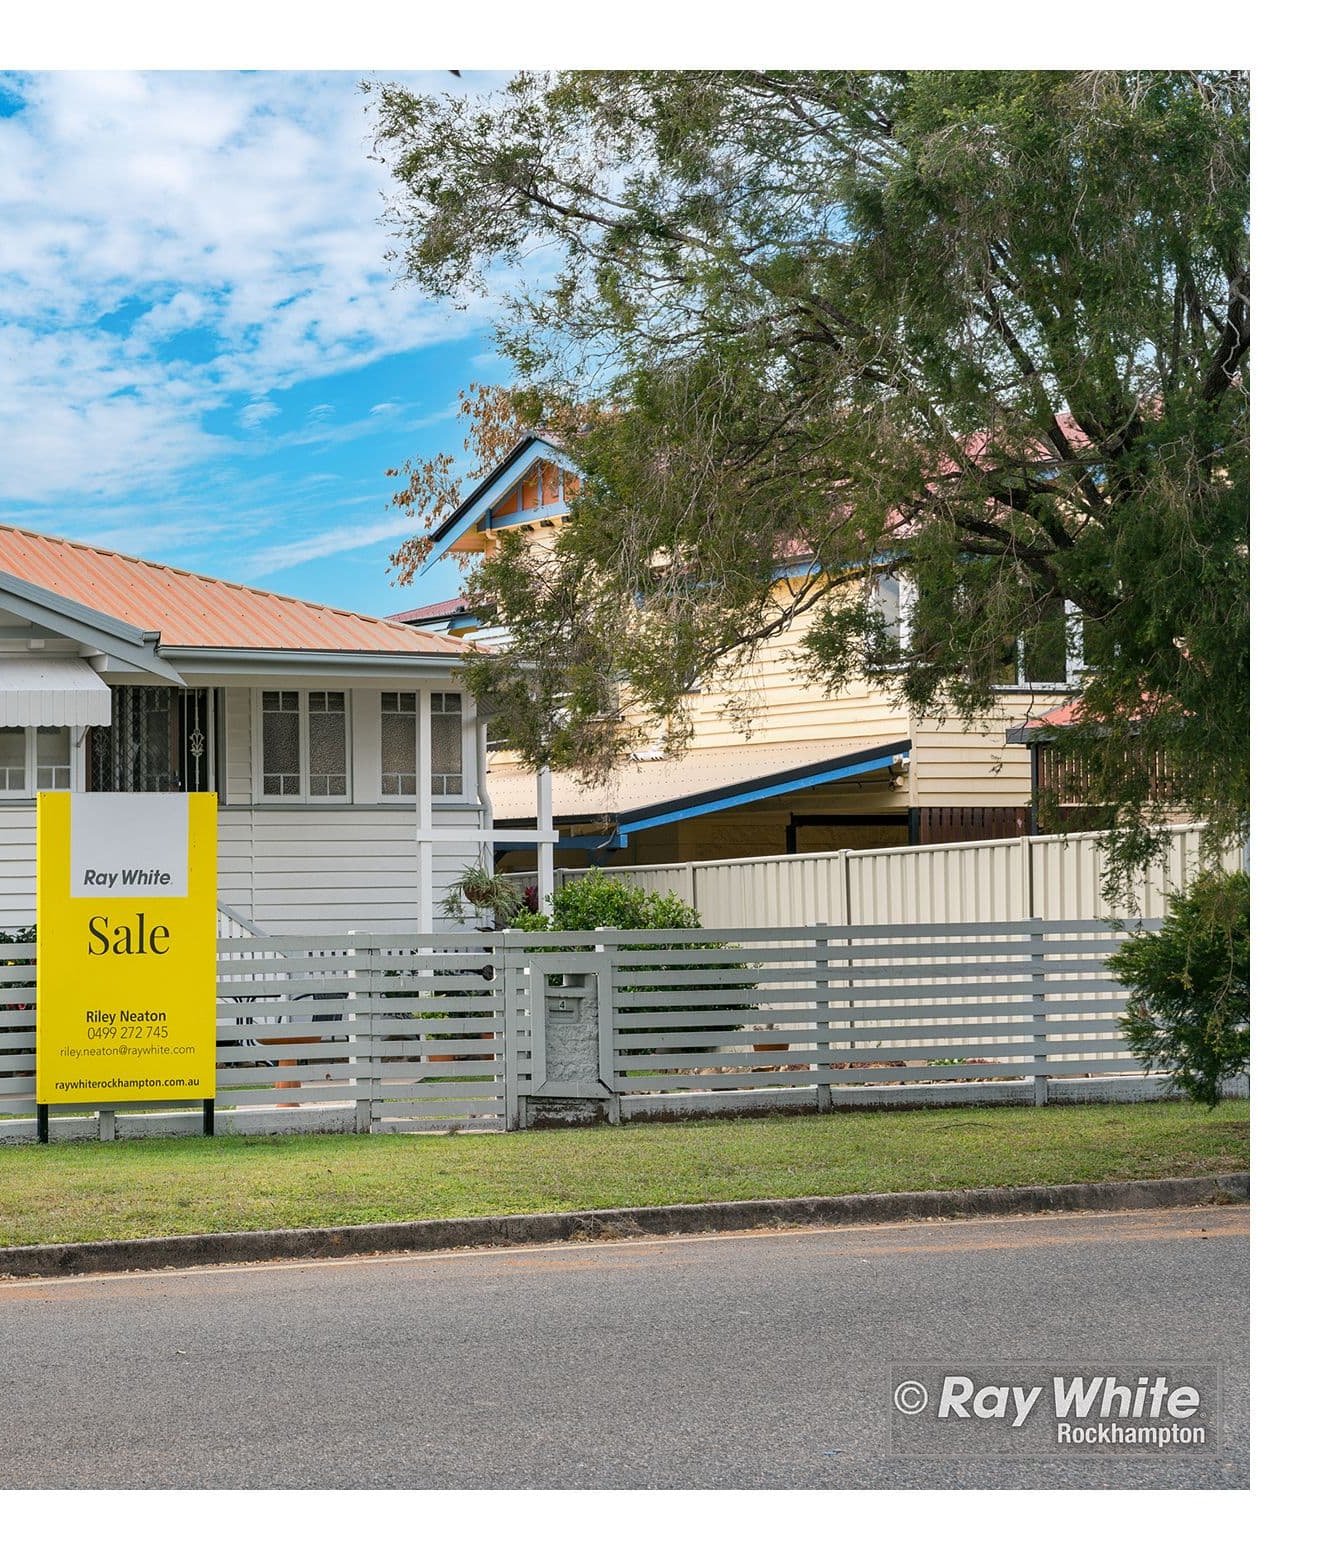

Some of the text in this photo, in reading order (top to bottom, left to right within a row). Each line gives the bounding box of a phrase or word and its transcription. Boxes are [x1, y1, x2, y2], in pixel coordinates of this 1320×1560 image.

[84, 869, 171, 888] Ray White
[88, 912, 170, 956] Sale
[86, 1010, 167, 1025] Riley Neaton
[87, 1025, 169, 1039] 0499 272 745
[60, 1044, 196, 1059] riley.neaton@raywhite.com
[55, 1077, 200, 1092] raywhiterockhampton.com.au
